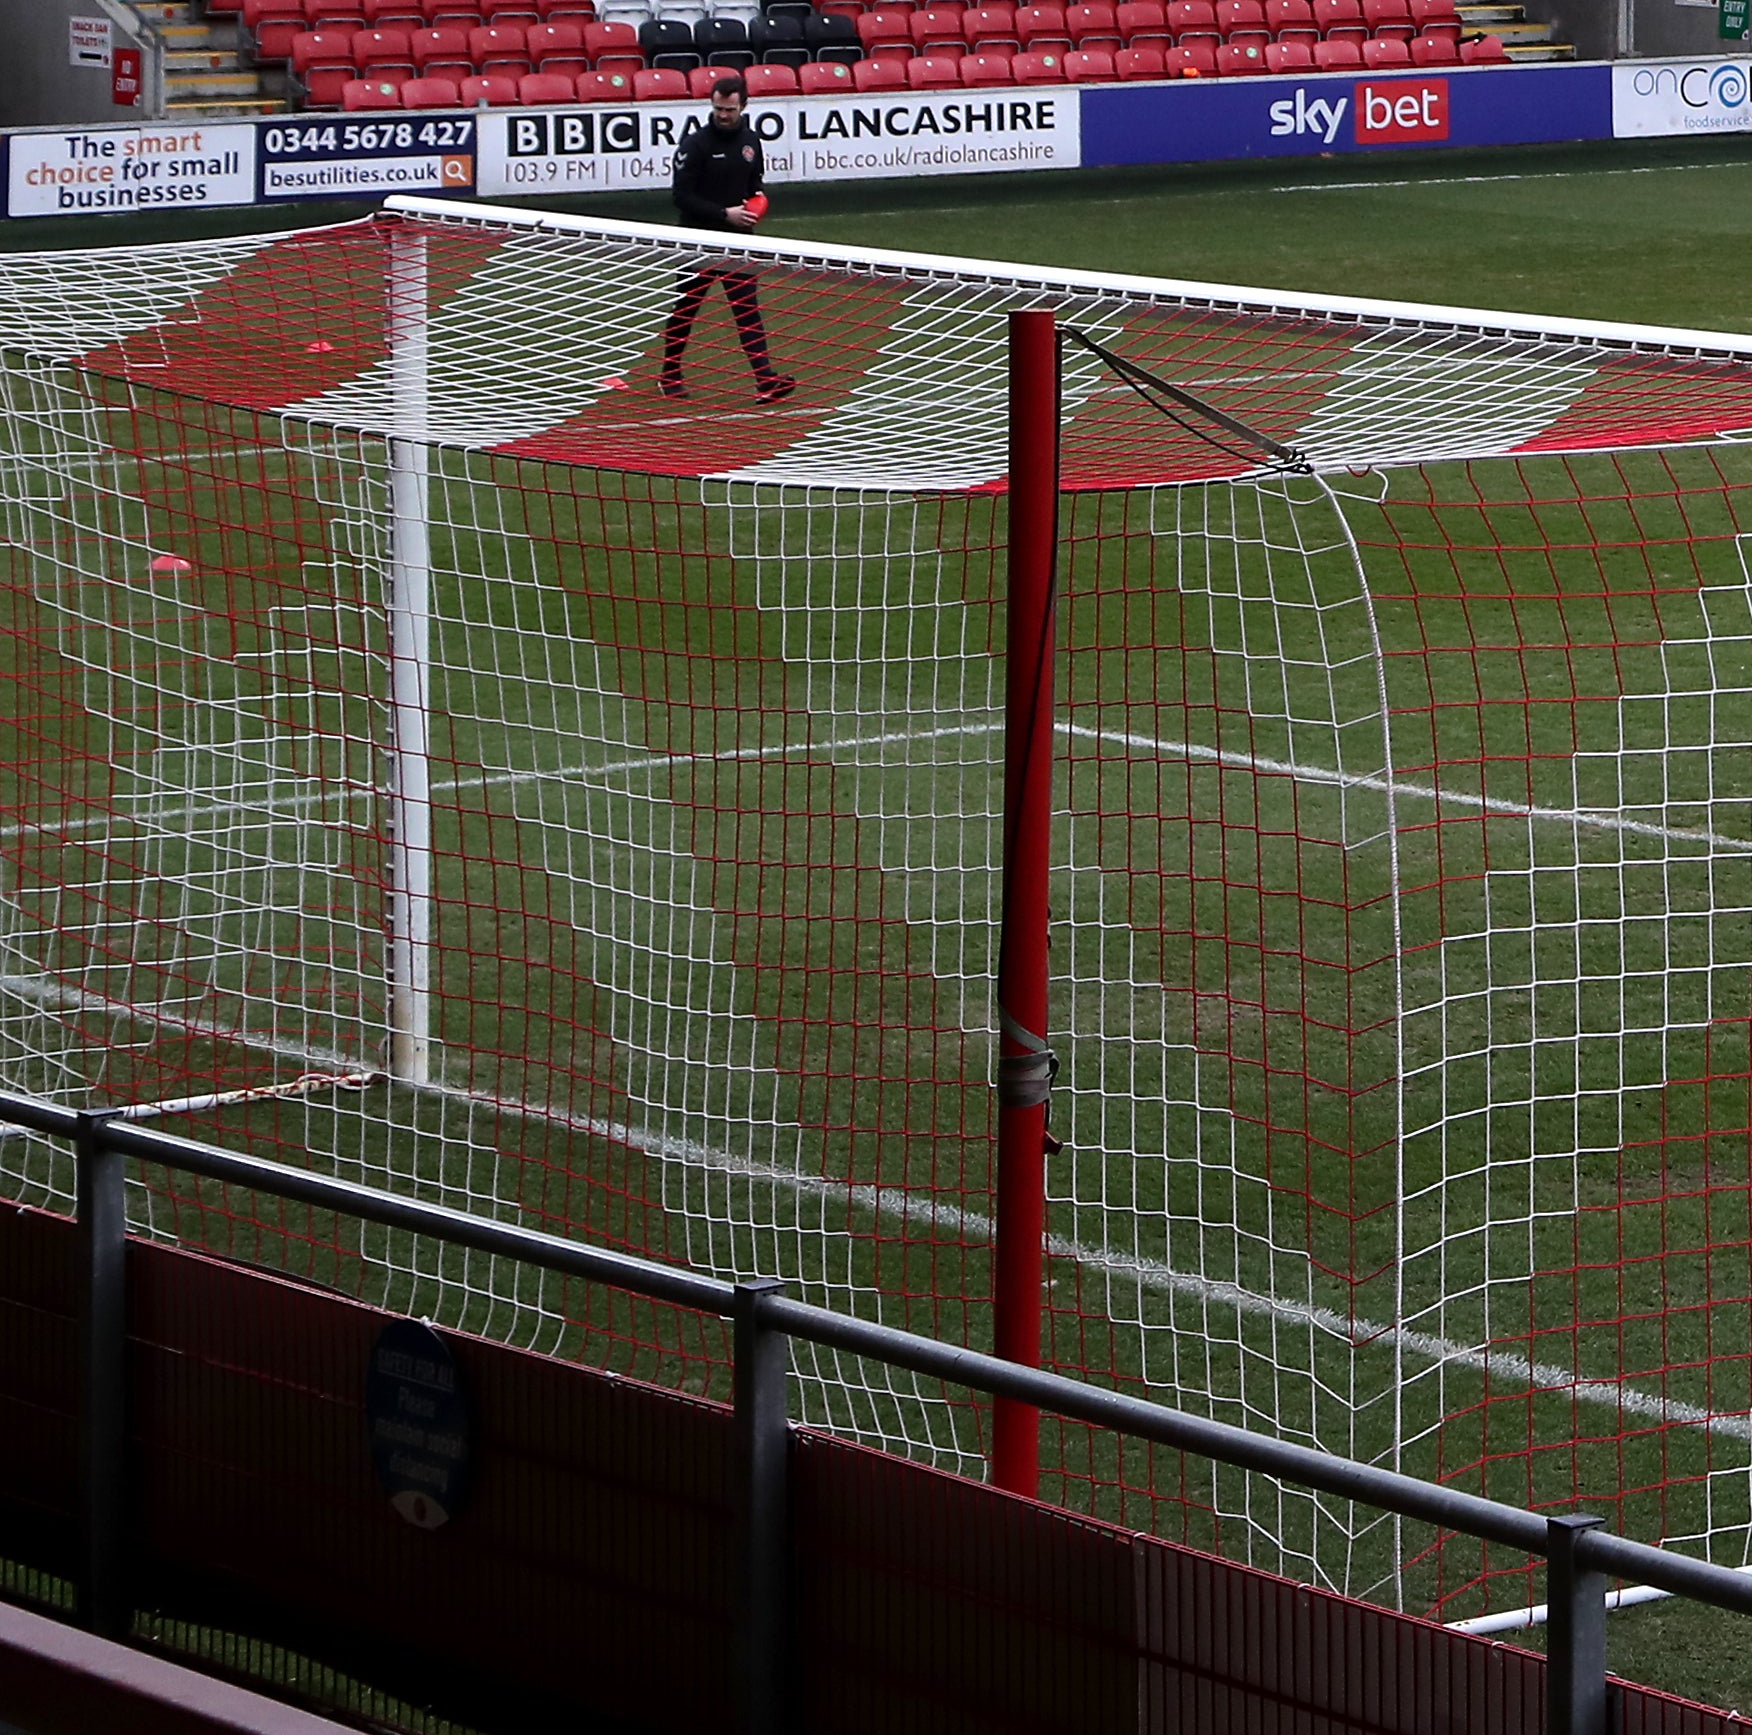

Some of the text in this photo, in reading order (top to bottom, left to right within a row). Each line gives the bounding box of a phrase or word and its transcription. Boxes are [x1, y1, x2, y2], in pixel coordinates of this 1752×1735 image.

[1723, 0, 1747, 14] ENTRY
[1725, 15, 1744, 29] ONLY
[507, 112, 641, 158] BBC
[800, 100, 1057, 140] LANCASHIRE
[1269, 88, 1440, 144] sky bet
[65, 132, 203, 160] The smart
[264, 120, 472, 153] 0344 5678 427
[25, 152, 239, 185] choice for small
[269, 152, 439, 188] besutilities.co.uk
[502, 156, 558, 184] 103.9
[565, 155, 597, 180] FM
[814, 141, 1055, 172] bbc.co.uk/radiolancashire
[58, 180, 208, 210] businesses
